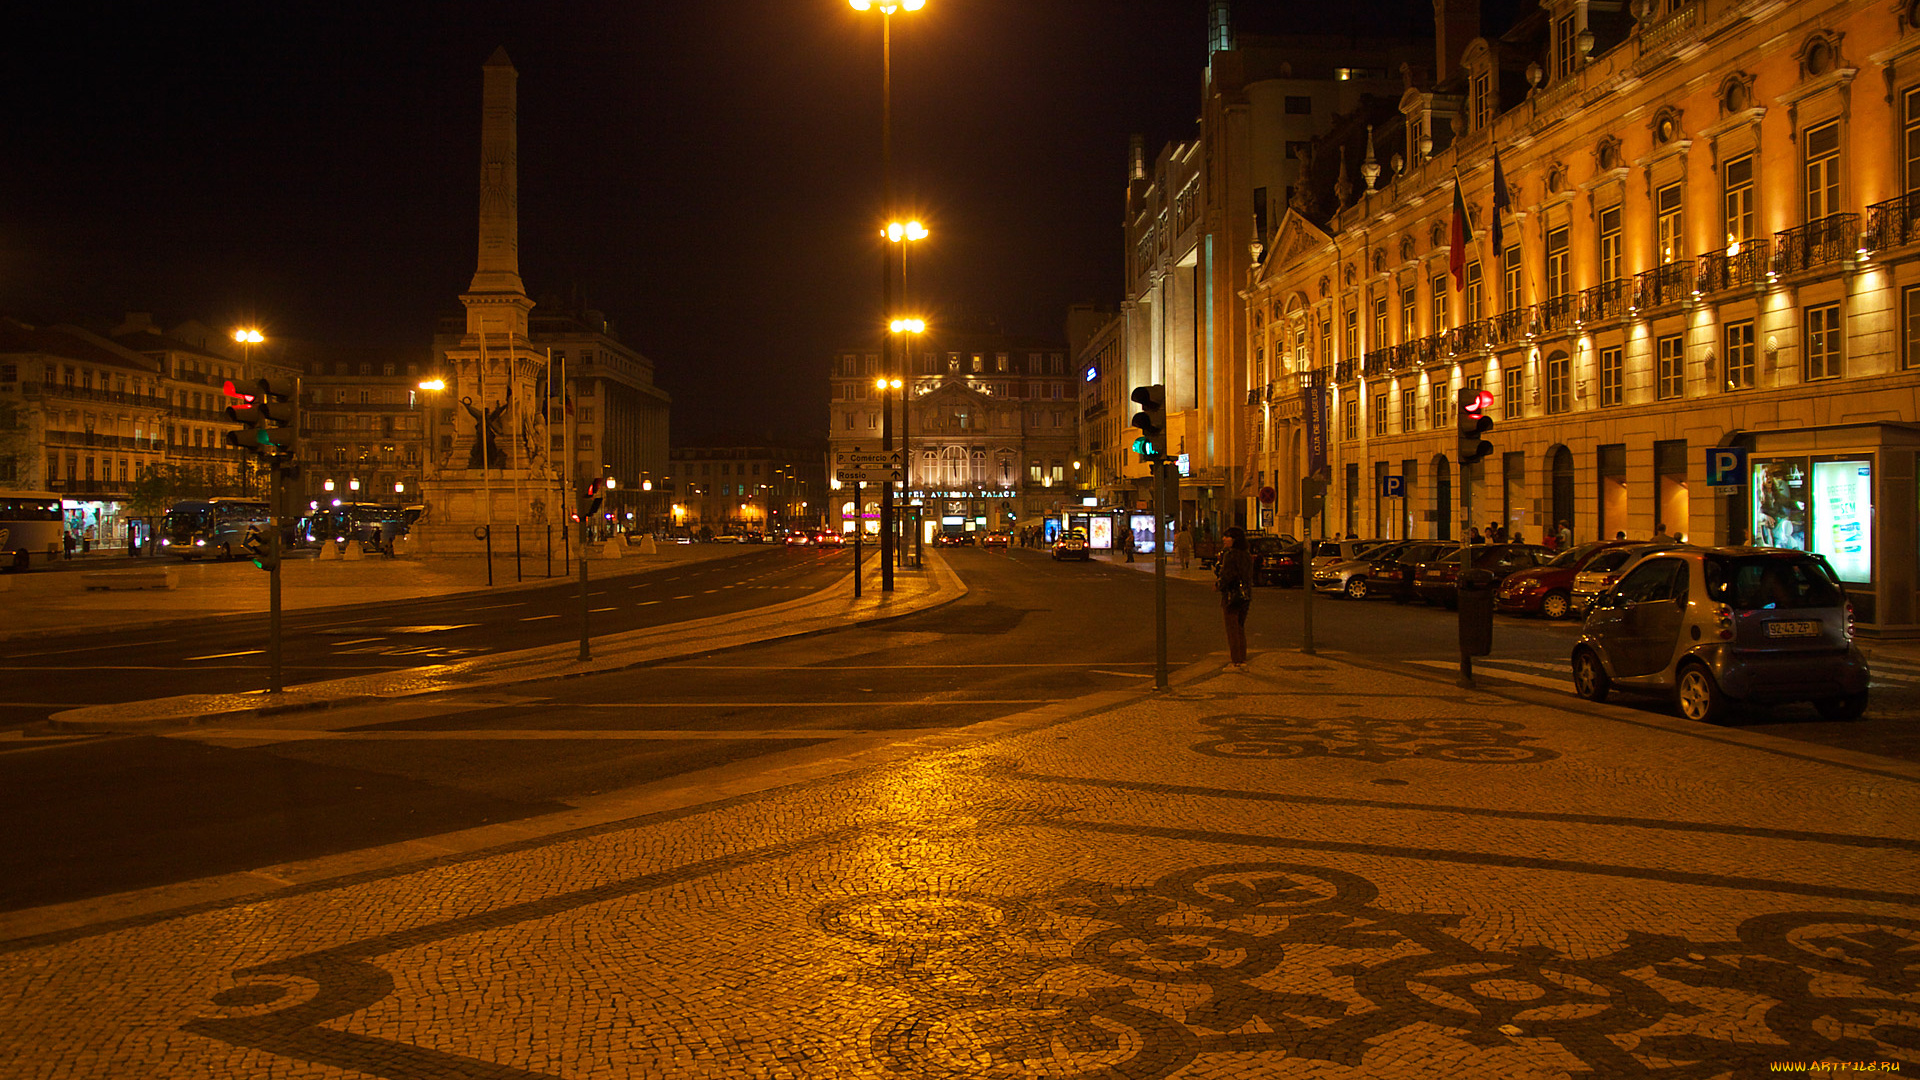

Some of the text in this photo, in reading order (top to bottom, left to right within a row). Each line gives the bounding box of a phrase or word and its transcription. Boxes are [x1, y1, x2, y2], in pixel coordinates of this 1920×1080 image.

[1311, 389, 1320, 423] MUSEUS
[1313, 423, 1320, 434] DE
[1715, 452, 1738, 482] P
[838, 471, 867, 479] Rossio
[1388, 477, 1400, 495] P
[893, 490, 925, 498] HOTEL
[980, 490, 1016, 498] PALACE
